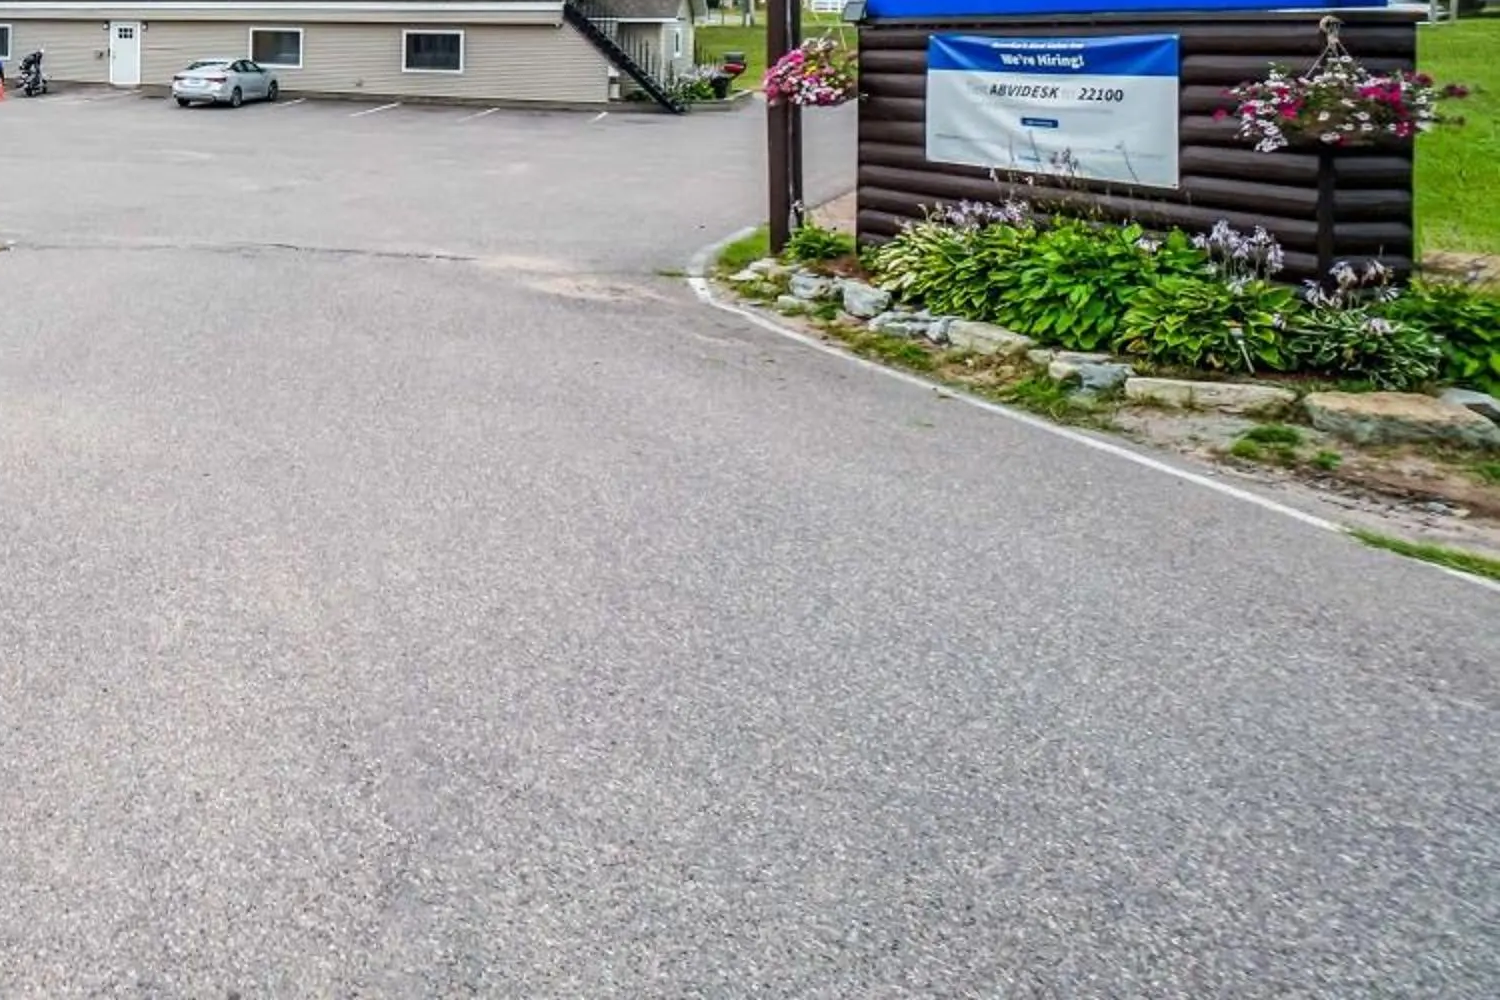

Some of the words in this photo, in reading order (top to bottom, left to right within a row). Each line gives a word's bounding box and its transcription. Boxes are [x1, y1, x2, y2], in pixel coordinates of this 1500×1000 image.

[1001, 53, 1035, 66] We're
[1037, 53, 1085, 69] Hiring!
[989, 83, 1061, 99] ABVIDESK
[1077, 87, 1125, 102] 22100
